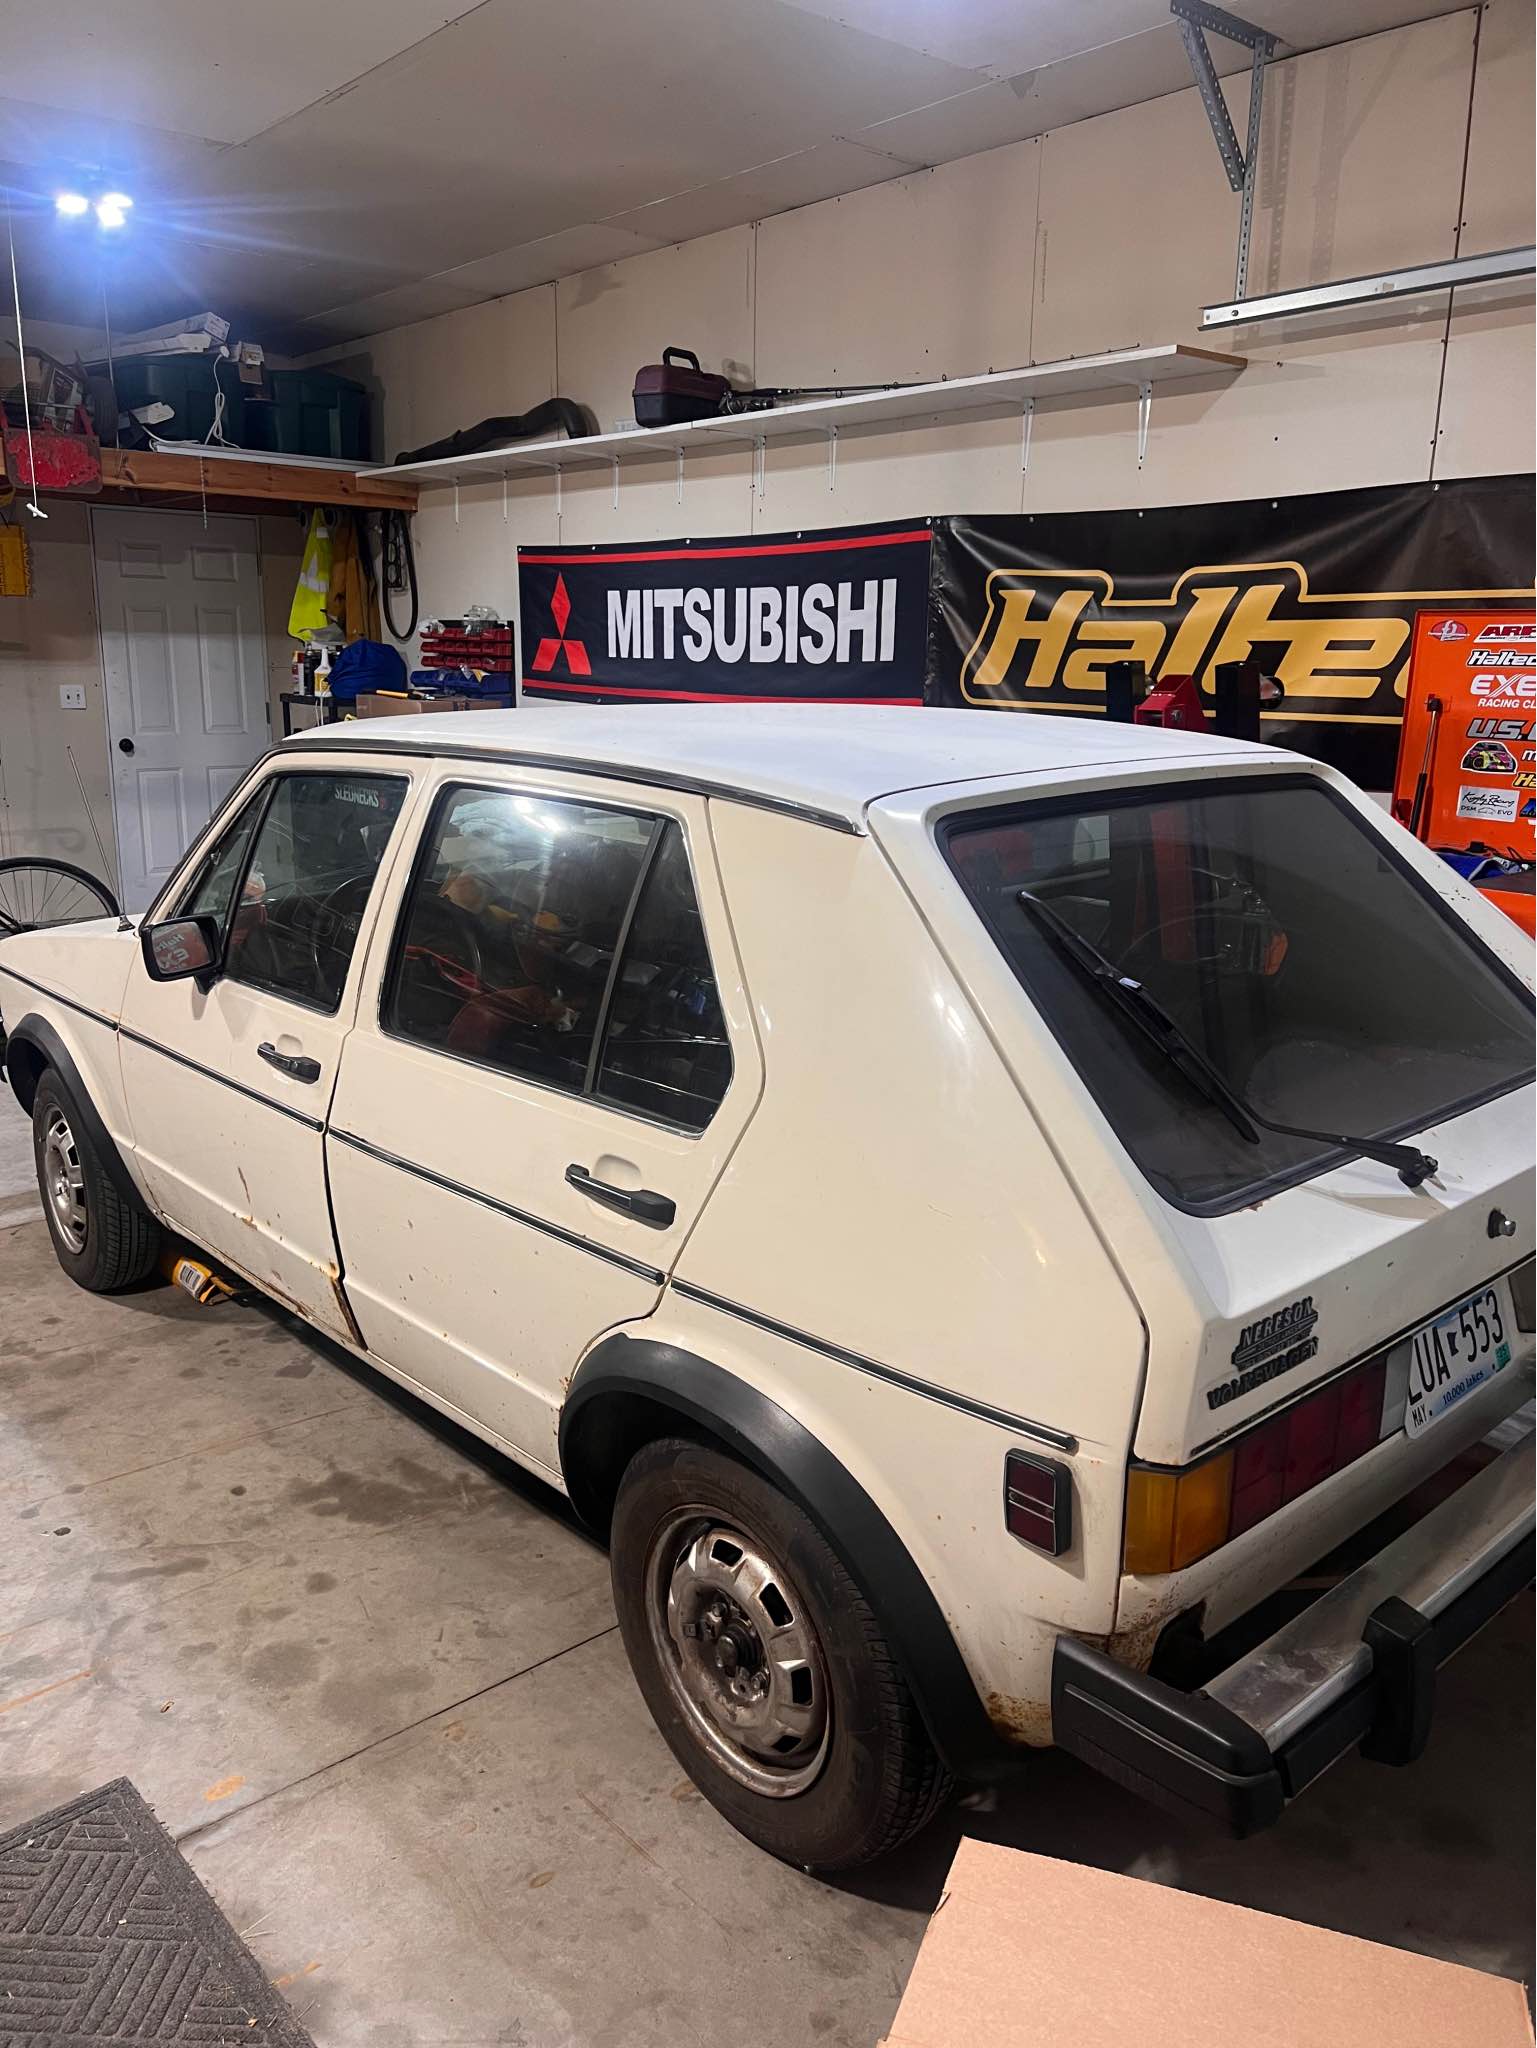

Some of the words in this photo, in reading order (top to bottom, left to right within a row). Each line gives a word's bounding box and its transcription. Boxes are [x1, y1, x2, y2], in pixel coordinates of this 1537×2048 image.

[607, 578, 897, 664] MITSUBISHI
[973, 584, 1413, 698] Halte
[1470, 674, 1536, 696] EXE
[1478, 698, 1520, 709] RACING
[1458, 1289, 1504, 1363] 553
[1411, 1404, 1427, 1428] MAY
